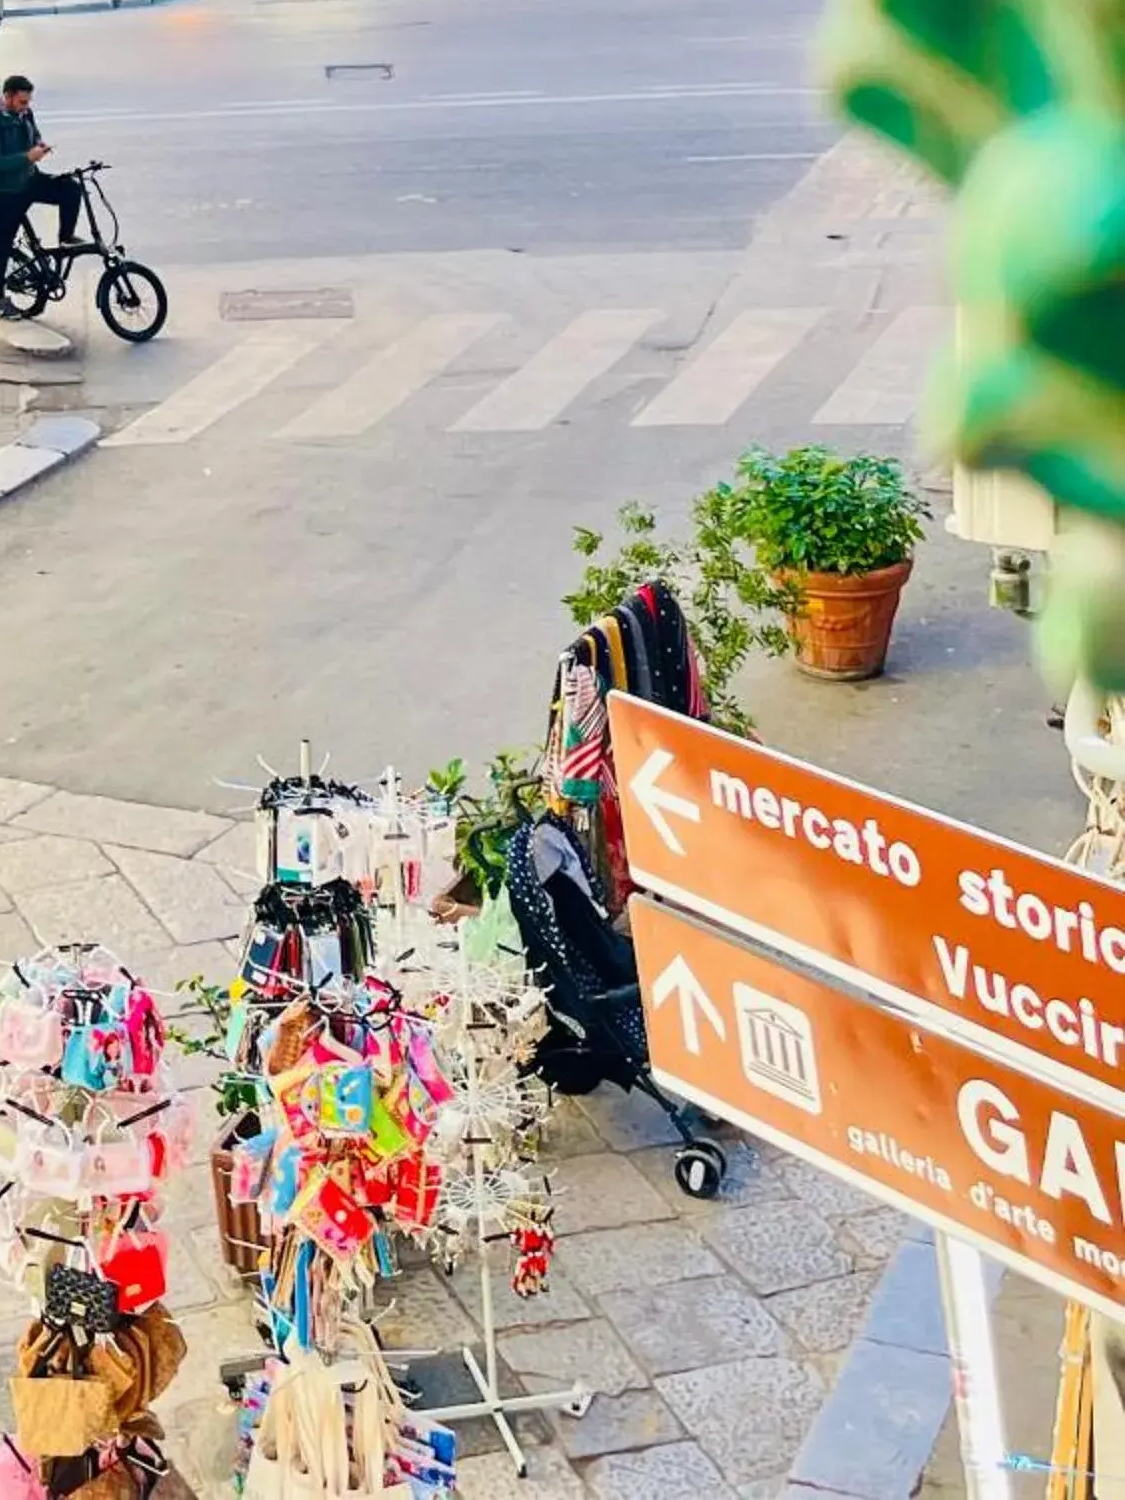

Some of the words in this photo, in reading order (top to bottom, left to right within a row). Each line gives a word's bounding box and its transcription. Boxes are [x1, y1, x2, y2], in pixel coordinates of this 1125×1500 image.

[709, 768, 921, 887] mercato
[932, 934, 1125, 1069] Vuccir
[846, 1125, 953, 1192] galleria
[969, 1180, 1055, 1244] d'arte
[957, 1078, 1125, 1228] GA
